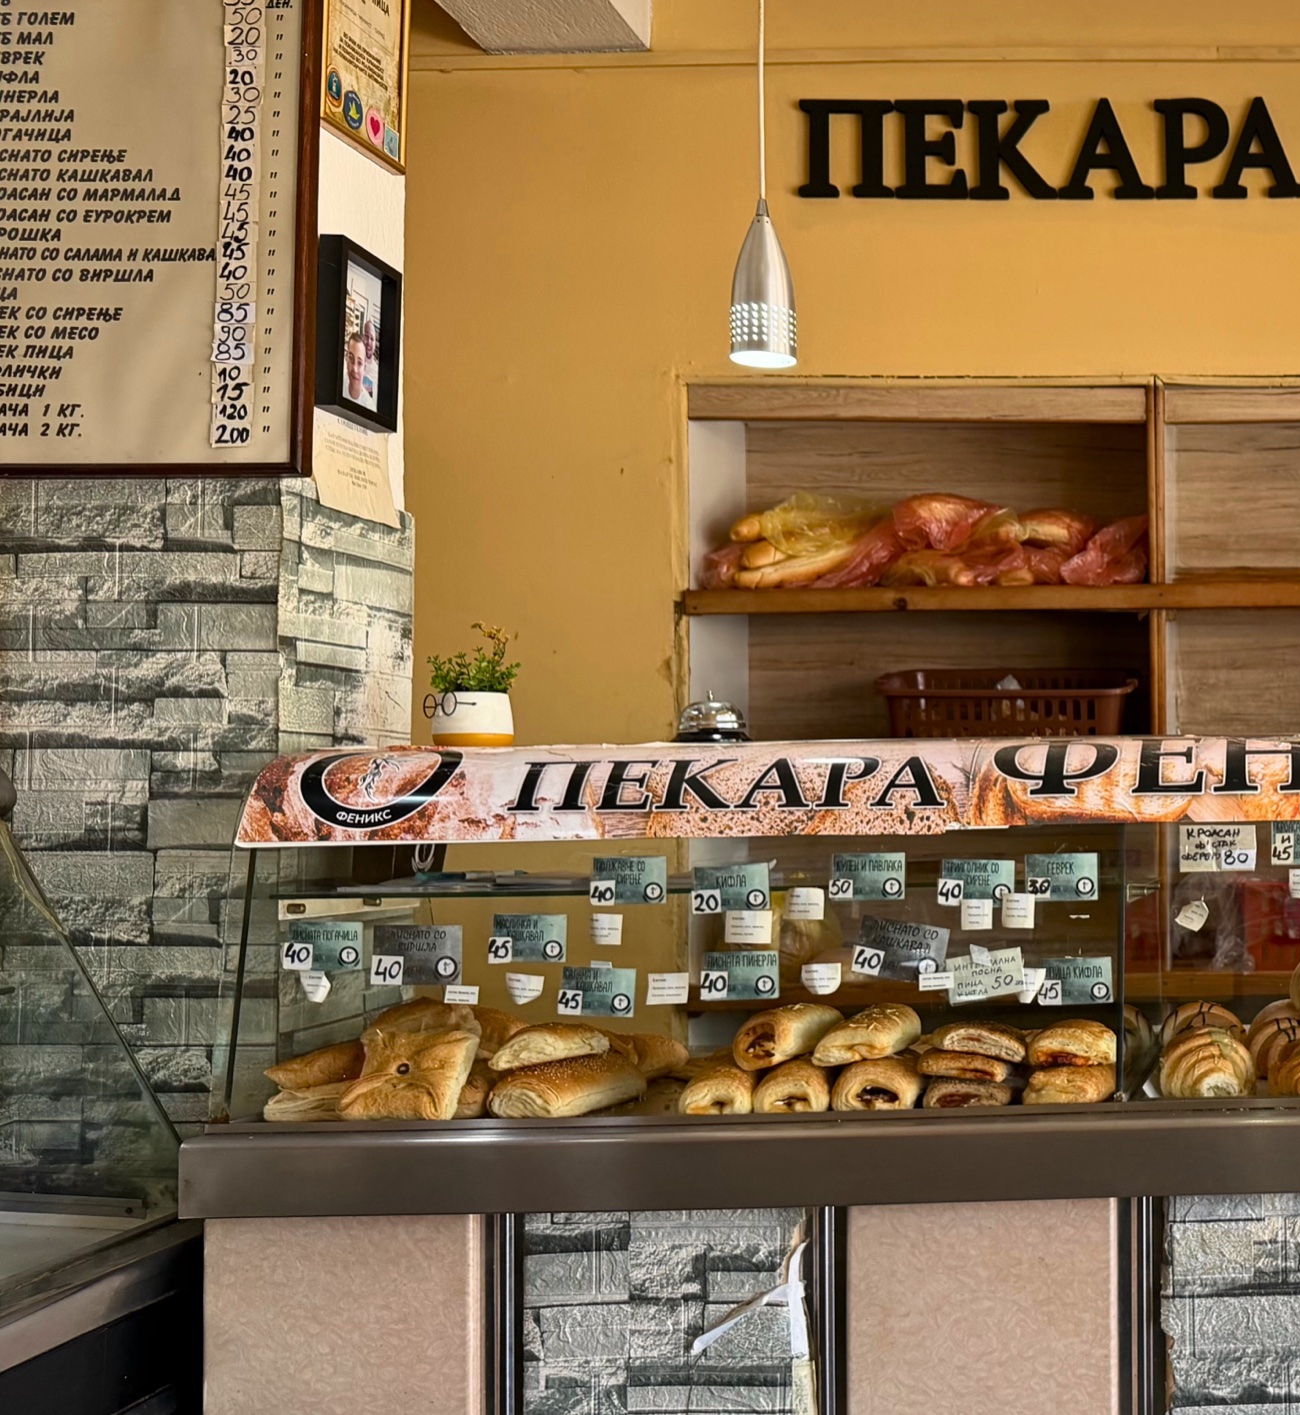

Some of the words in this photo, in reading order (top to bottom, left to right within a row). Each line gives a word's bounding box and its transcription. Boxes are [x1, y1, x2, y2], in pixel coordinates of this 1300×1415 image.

[17, 12, 75, 25] ГОЛЕМ
[229, 7, 262, 26] 50
[16, 32, 54, 45] МАЛ
[227, 27, 261, 45] 20
[0, 51, 46, 66] ВРЕК
[233, 49, 258, 63] 30
[229, 69, 254, 86] 20
[226, 87, 260, 103] 30
[228, 105, 257, 125] 25
[0, 128, 71, 144] ГАЧИЦА
[227, 126, 255, 142] 40
[58, 149, 127, 164] СИРЕЊЕ
[224, 145, 251, 162] 40
[56, 168, 154, 183] КАШКАВАЛ
[224, 164, 253, 182] 40
[57, 187, 78, 201] СО
[82, 187, 181, 202] МАРМАЛАД
[224, 183, 252, 201] 45
[56, 209, 78, 223] СО
[83, 209, 172, 224] ЕУРОКРЕМ
[222, 201, 249, 223] 45
[221, 222, 249, 241] 45
[41, 247, 60, 261] СО
[63, 247, 122, 262] САЛАМА
[127, 248, 138, 262] И
[141, 248, 217, 262] КАШКАВА
[222, 241, 250, 260] 45
[51, 268, 73, 282] СО
[79, 268, 154, 283] ВИРШЛА
[219, 262, 248, 281] 40
[220, 283, 250, 301] 50
[25, 306, 48, 320] СО
[52, 306, 124, 322] СИРЕЊЕ
[216, 302, 250, 322] 85
[24, 325, 46, 340] СО
[50, 326, 100, 341] МЕСО
[218, 325, 247, 343] 90
[23, 345, 74, 361] ПИЦА
[215, 342, 250, 361] 85
[0, 364, 63, 380] ЛИЧКИ
[217, 366, 242, 382] 10
[216, 382, 251, 401] 15
[42, 403, 51, 417] 1
[57, 403, 85, 419] КГ.
[217, 403, 248, 420] 120
[40, 423, 51, 437] 2
[56, 423, 82, 438] КГ.
[215, 424, 250, 444] 200
[507, 756, 946, 813] ПЕКАРА
[336, 809, 392, 824] ФЕНИКС
[1186, 827, 1241, 841] КРОАСАН
[1224, 849, 1249, 866] 80
[1272, 845, 1293, 861] 45
[868, 859, 903, 872] ПАВЛАКА
[1046, 861, 1075, 875] ГЕВРЕК
[716, 874, 746, 889] КИФЛА
[829, 879, 852, 896] 50
[590, 886, 615, 903] 40
[939, 880, 962, 902] 40
[694, 893, 719, 913] 20
[433, 930, 447, 940] СО
[923, 927, 939, 941] СО
[285, 943, 311, 964] 40
[488, 938, 511, 959] 45
[742, 954, 777, 968] ПИНЕРЛА
[854, 948, 882, 970] 40
[375, 958, 402, 983] 40
[1073, 965, 1103, 979] КИФЛА
[700, 972, 727, 994] 40
[991, 974, 1014, 990] 50
[558, 990, 581, 1010] 45
[1038, 982, 1060, 1001] 45
